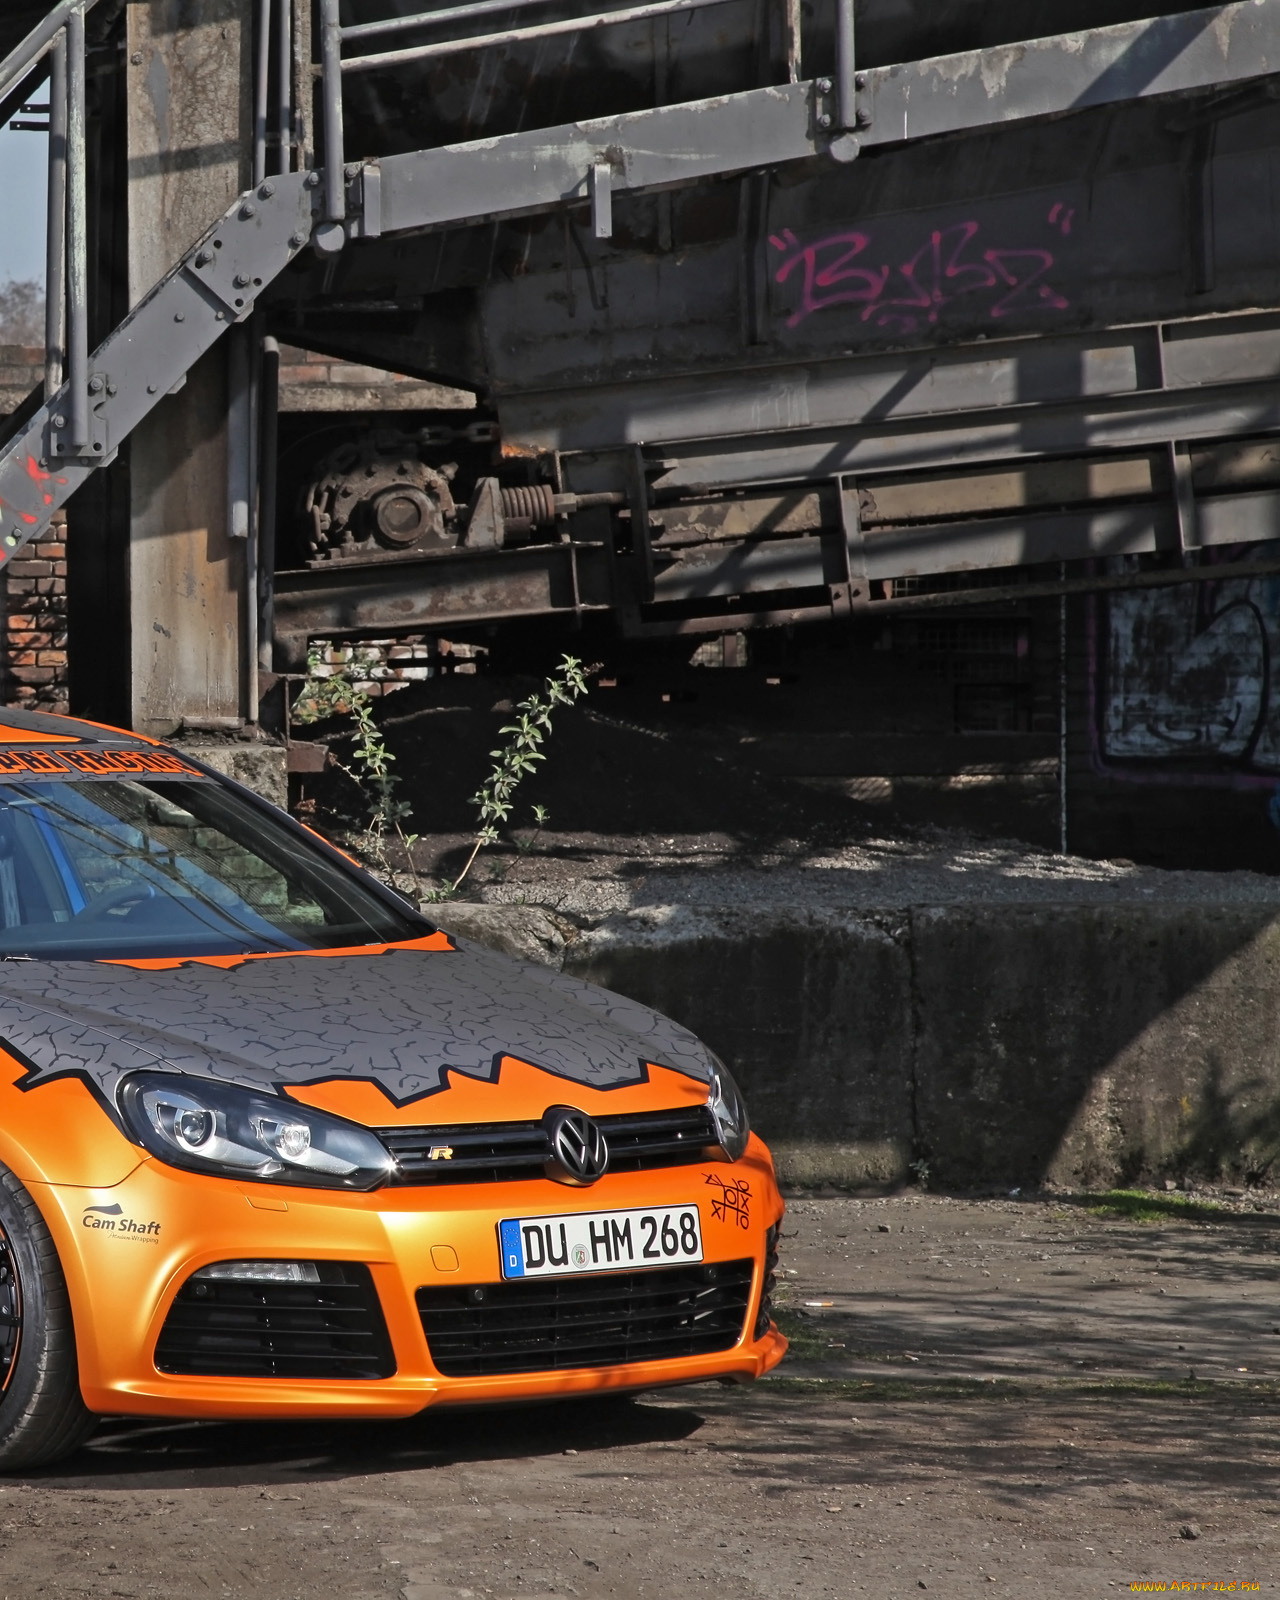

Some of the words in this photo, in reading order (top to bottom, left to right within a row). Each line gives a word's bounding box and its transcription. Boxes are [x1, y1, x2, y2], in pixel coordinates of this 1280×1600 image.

[428, 1145, 453, 1160] R
[82, 1215, 116, 1231] Cam
[118, 1219, 161, 1236] Shaft
[131, 1235, 159, 1245] Wrapping
[522, 1222, 569, 1269] DU
[588, 1217, 634, 1263] HM
[640, 1212, 698, 1259] 268
[509, 1254, 518, 1267] D
